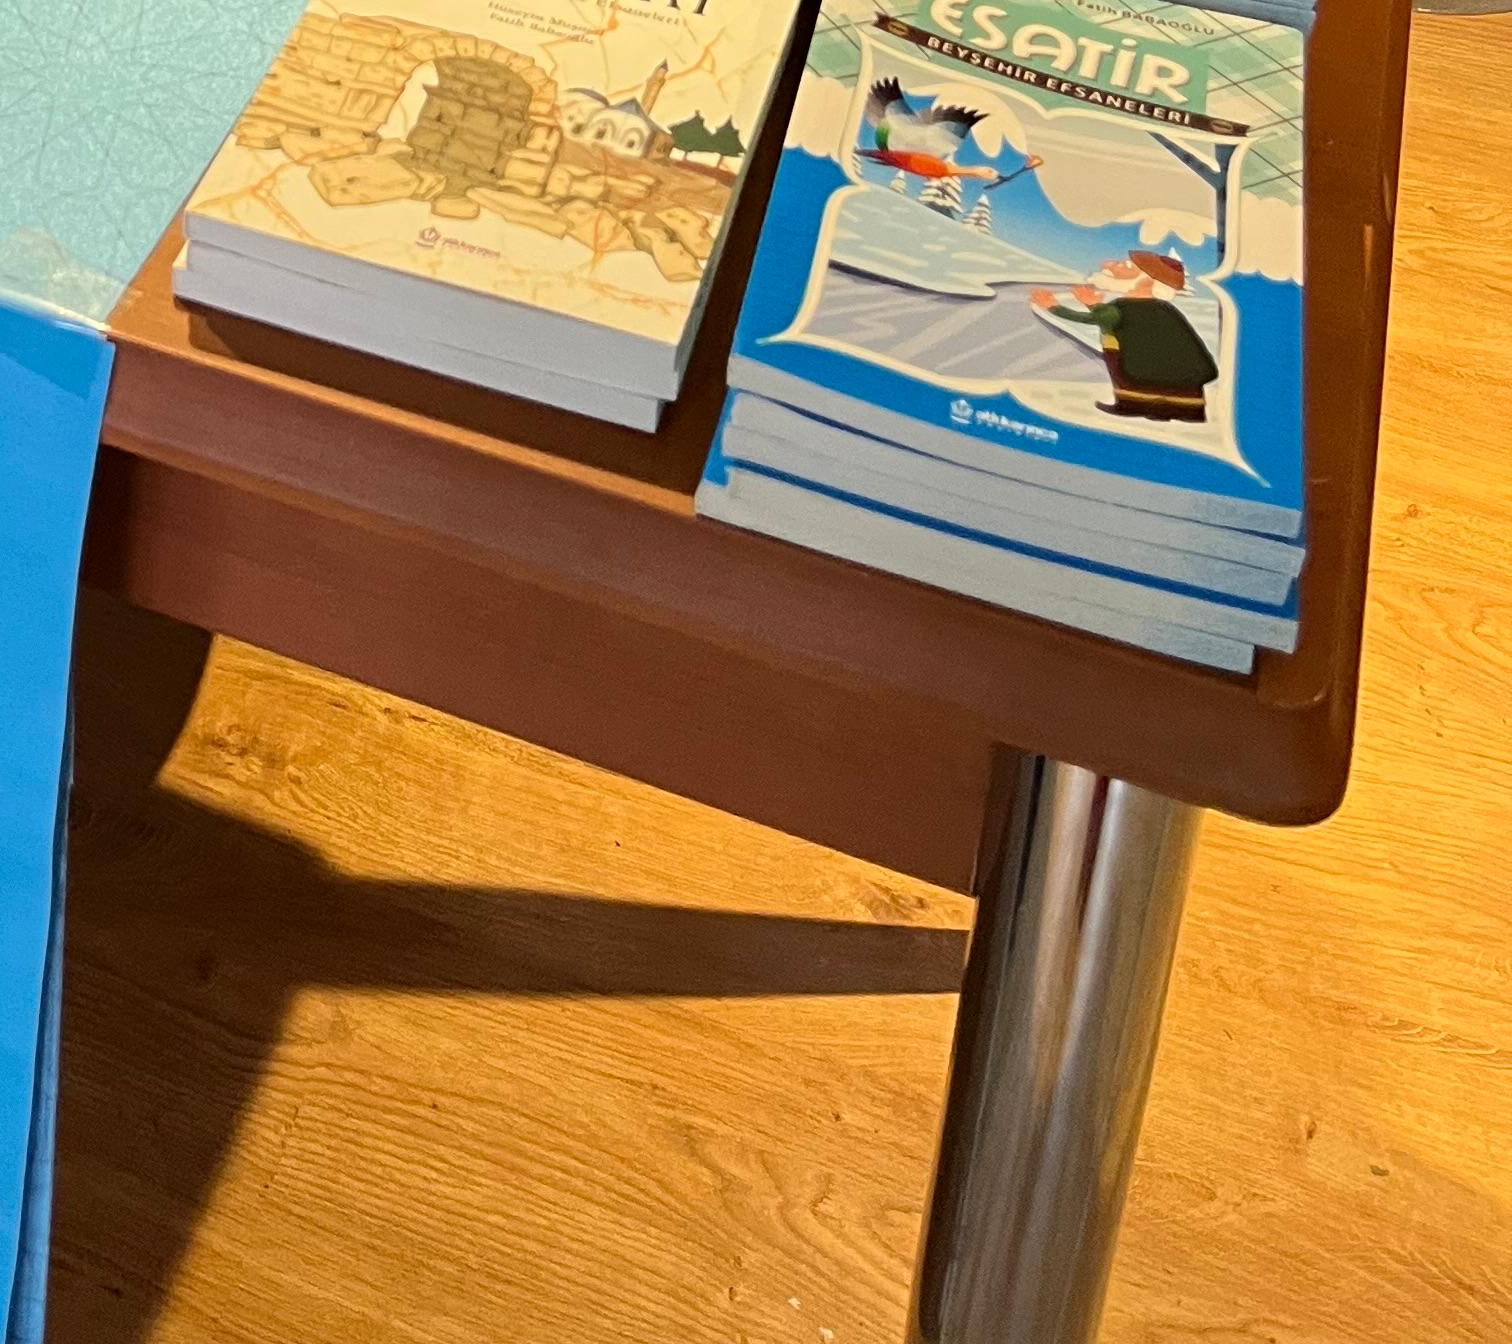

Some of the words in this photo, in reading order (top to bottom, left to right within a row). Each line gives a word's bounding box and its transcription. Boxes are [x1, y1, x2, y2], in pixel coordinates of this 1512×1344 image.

[1121, 8, 1216, 37] BABAOĞLU
[926, 35, 1038, 85] BEYŞEHİR
[1045, 76, 1191, 126] EFSANELERİ
